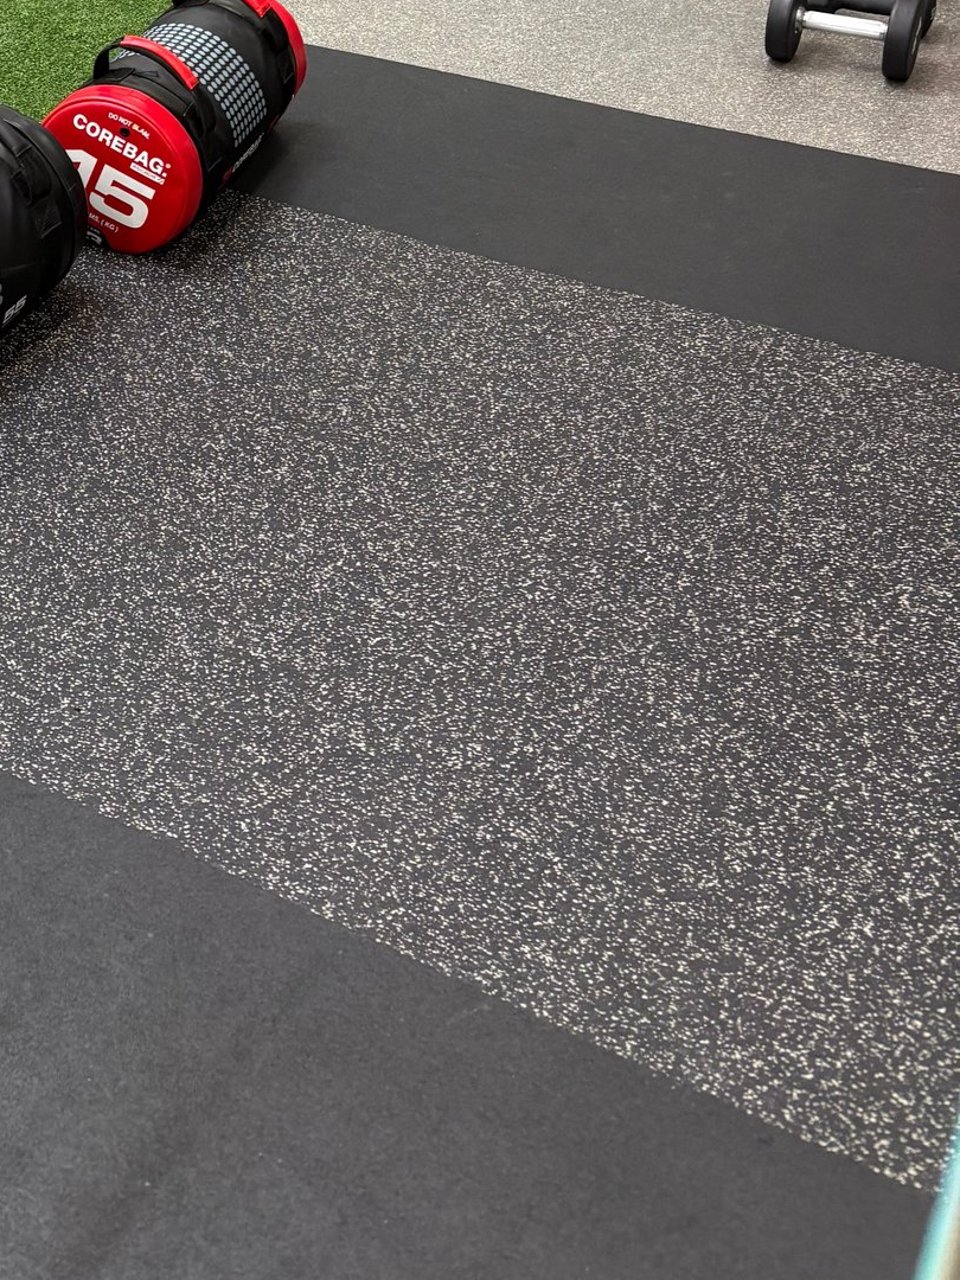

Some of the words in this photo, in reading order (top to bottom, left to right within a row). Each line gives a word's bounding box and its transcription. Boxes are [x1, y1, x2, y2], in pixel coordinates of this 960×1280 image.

[108, 112, 118, 121] DO
[118, 116, 132, 127] NOT
[3, 295, 27, 324] 55
